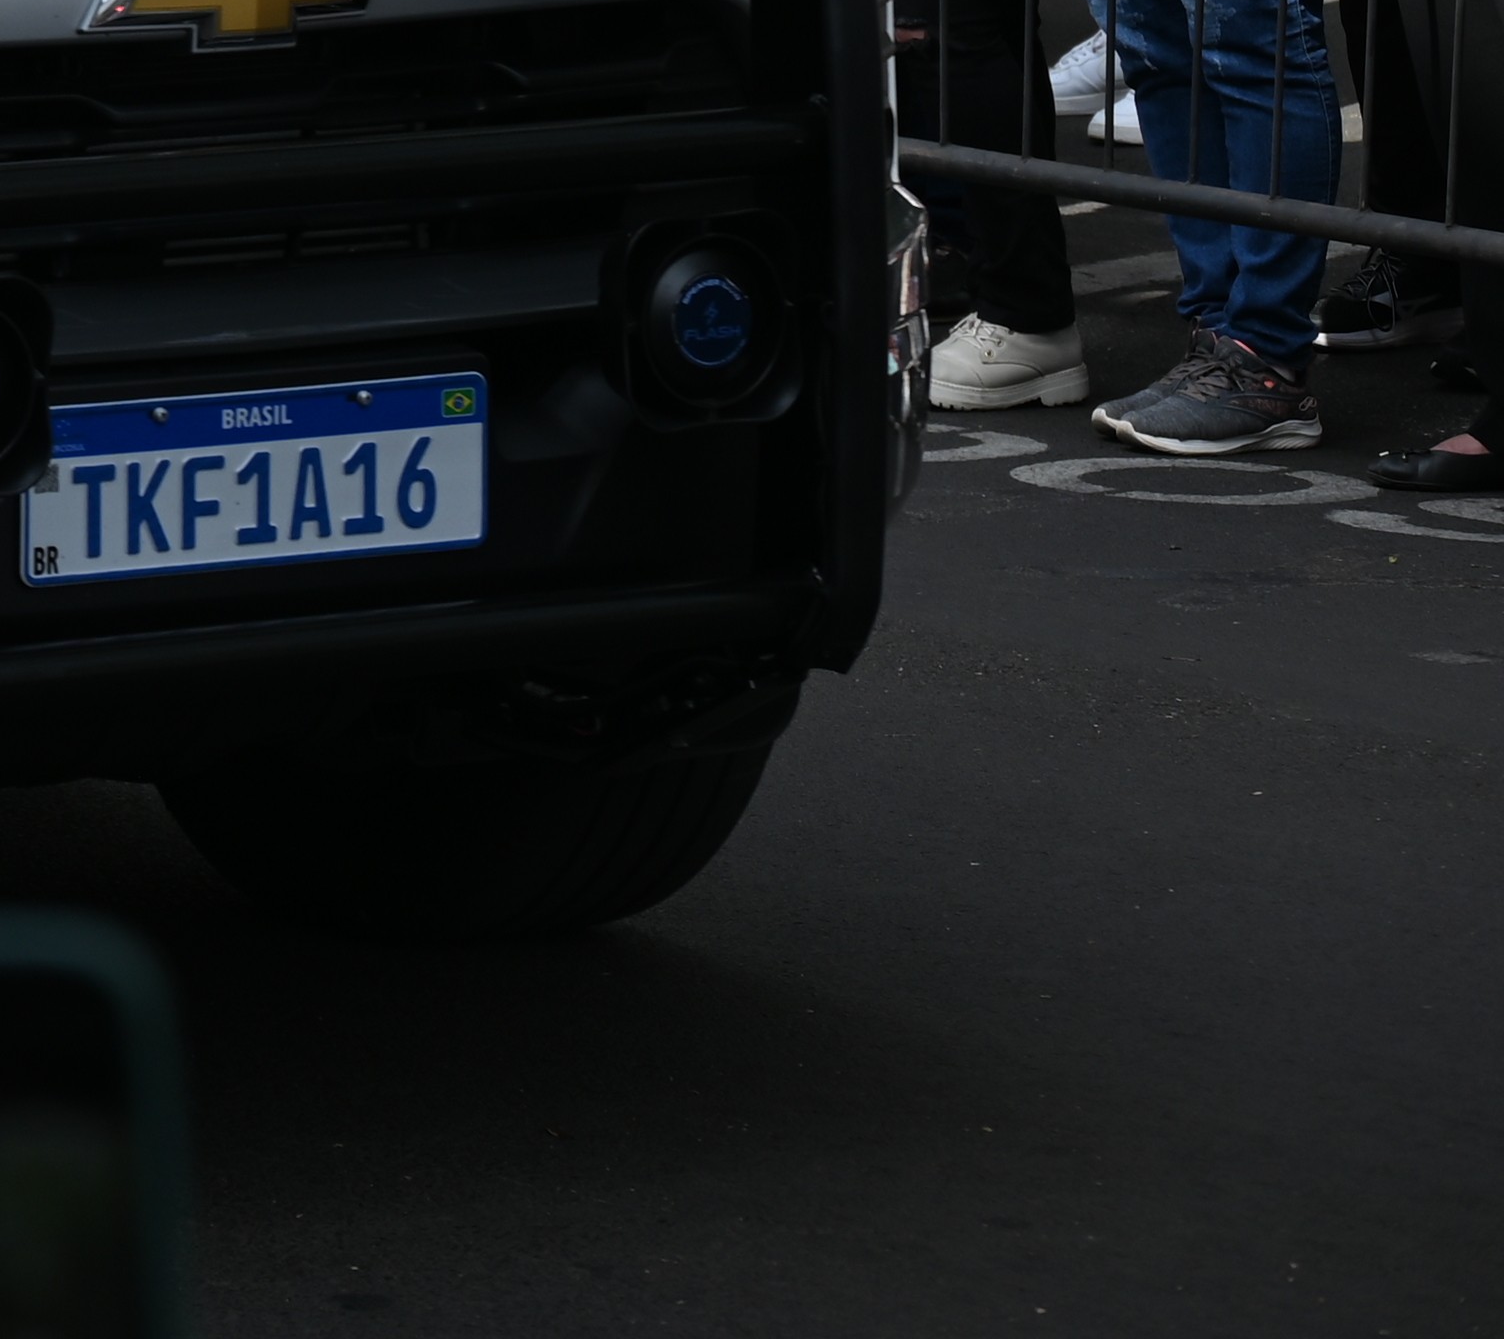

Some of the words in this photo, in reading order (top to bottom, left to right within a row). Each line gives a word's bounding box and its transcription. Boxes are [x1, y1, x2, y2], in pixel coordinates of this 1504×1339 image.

[221, 404, 294, 430] BRASIL
[71, 435, 437, 559] TKF1A16
[33, 546, 59, 577] BR
